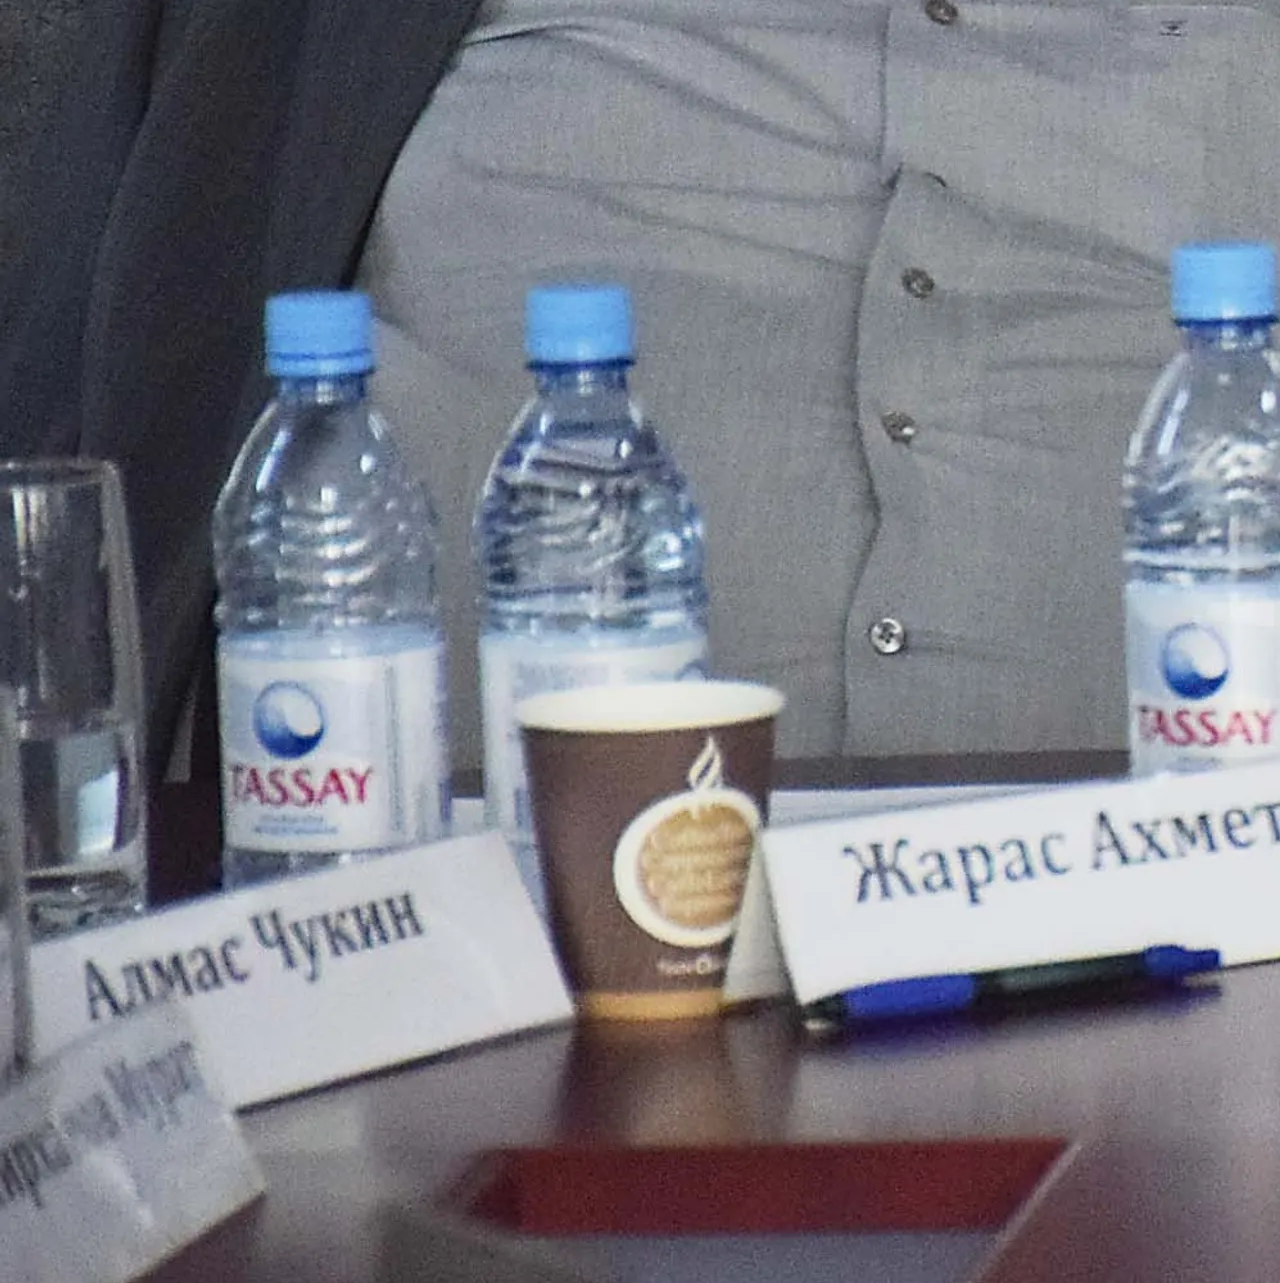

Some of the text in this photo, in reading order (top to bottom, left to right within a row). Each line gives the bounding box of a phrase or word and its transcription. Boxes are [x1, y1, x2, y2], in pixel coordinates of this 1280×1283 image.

[231, 763, 373, 807] TASSAY
[842, 830, 1073, 906] Жарас
[84, 890, 424, 1020] Алмас Чукин
